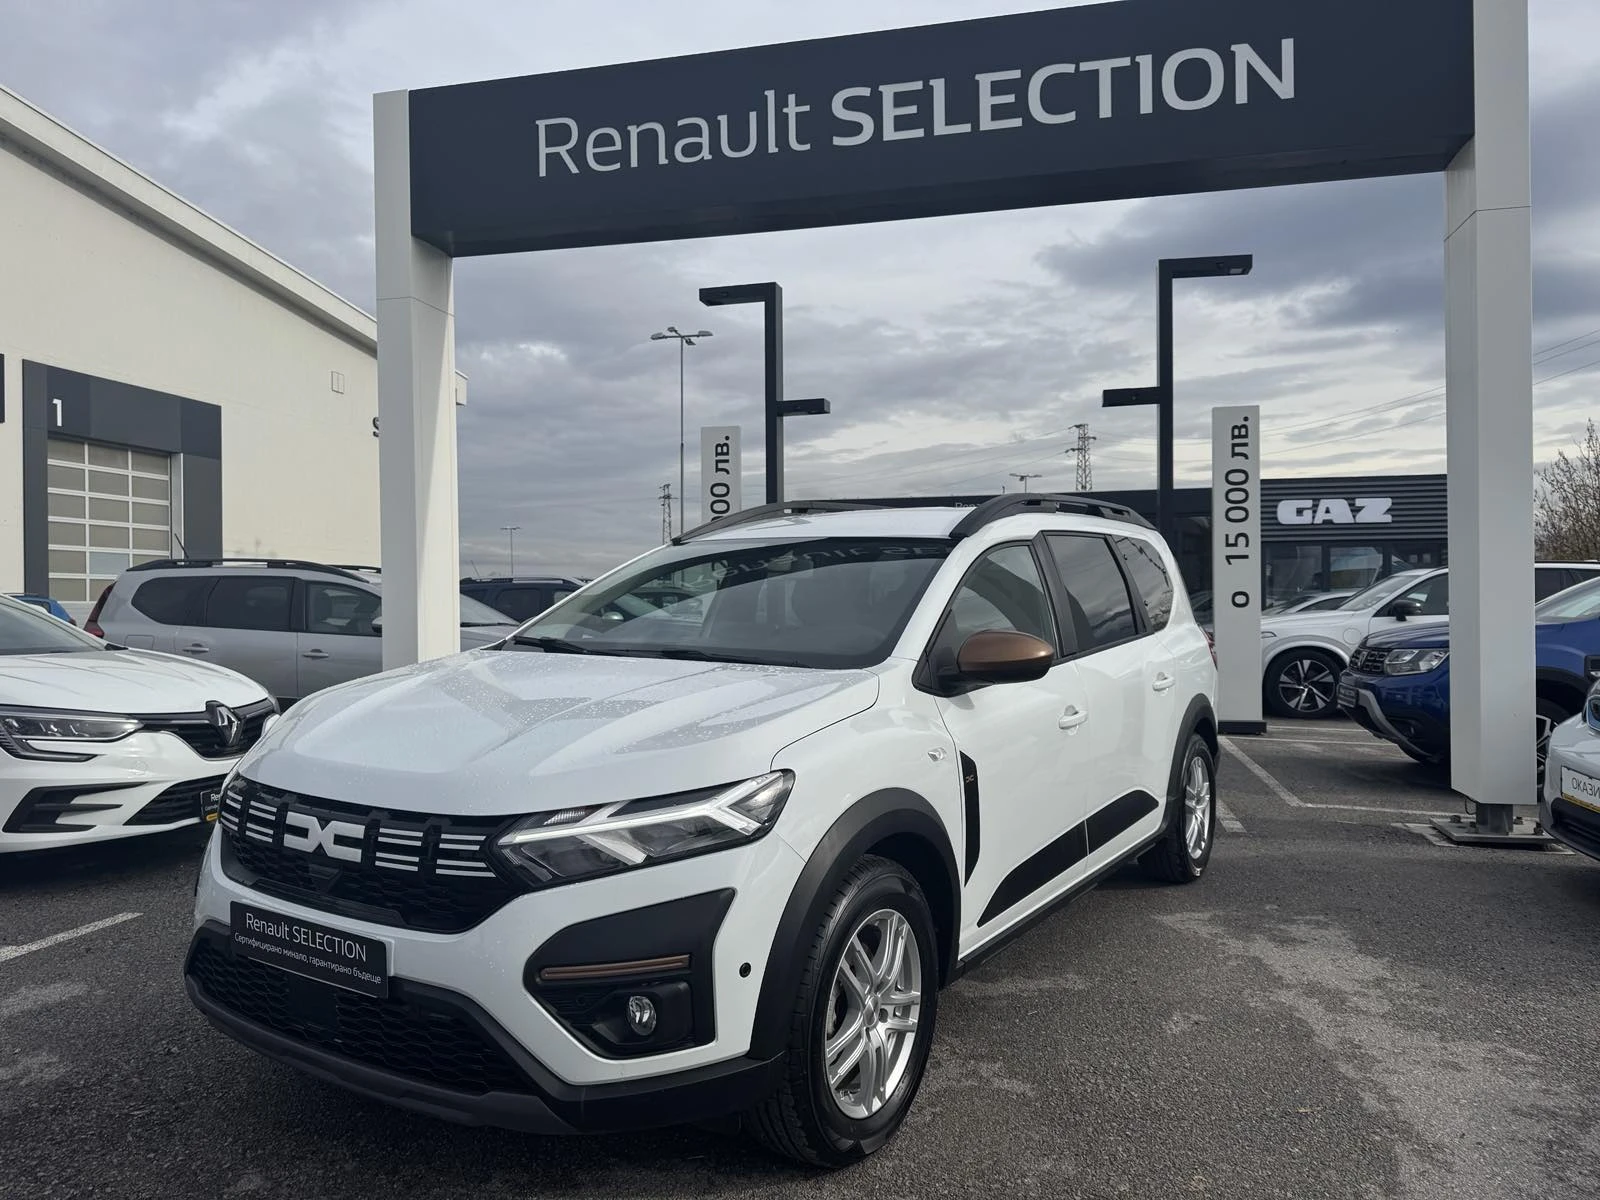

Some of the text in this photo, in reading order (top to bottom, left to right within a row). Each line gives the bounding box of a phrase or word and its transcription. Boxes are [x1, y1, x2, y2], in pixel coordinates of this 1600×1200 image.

[535, 37, 1295, 177] Renault SELECTION
[52, 398, 63, 427] 1
[710, 482, 730, 522] 00
[1225, 468, 1249, 523] 000
[1277, 497, 1393, 525] GAZ
[1225, 532, 1249, 565] 15
[234, 932, 283, 955] Сертифицирано
[309, 956, 352, 975] гарантирано
[353, 967, 381, 985] бъдеще
[246, 912, 367, 962] Renault SELECTION
